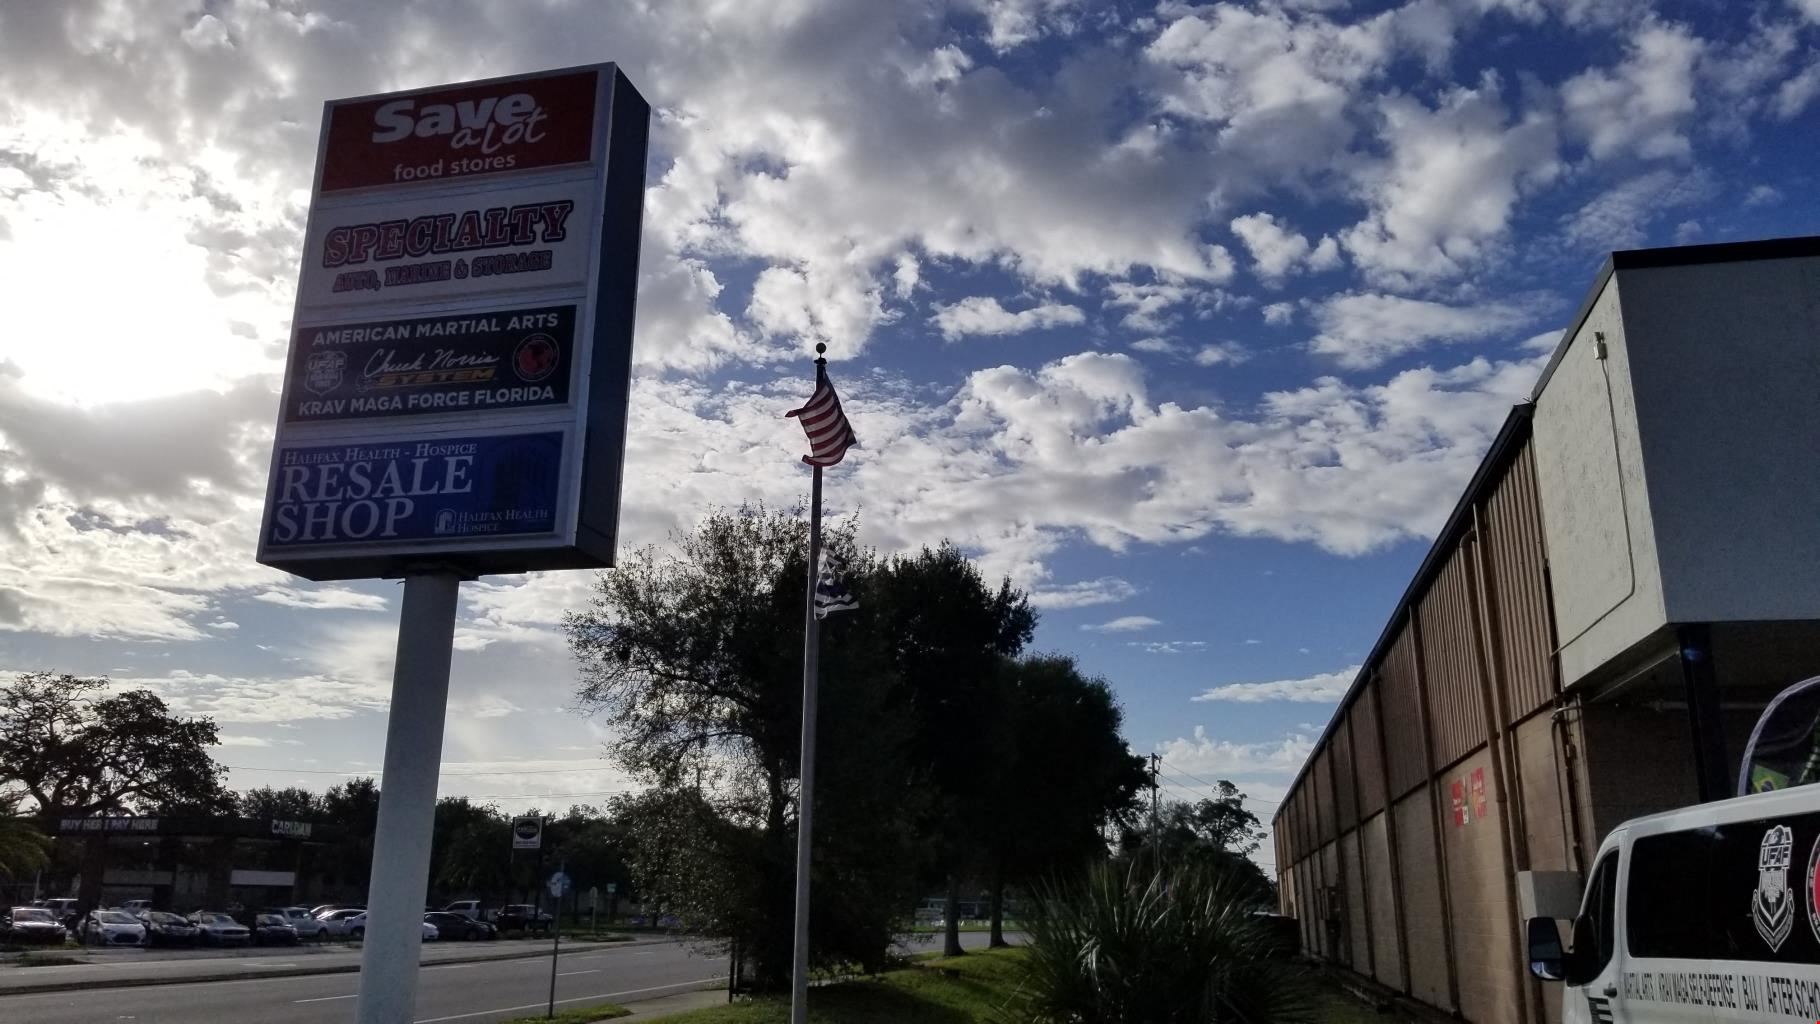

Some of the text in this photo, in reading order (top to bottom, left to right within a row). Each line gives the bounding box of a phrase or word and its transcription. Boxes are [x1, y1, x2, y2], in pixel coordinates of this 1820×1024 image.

[372, 93, 536, 143] Save
[393, 153, 516, 181] food stores
[323, 200, 575, 268] SPECIALTY
[384, 260, 452, 287] MARINE
[453, 258, 469, 280] &
[471, 250, 553, 278] STORAGE
[311, 313, 559, 346] AMERICAN MARTIAL ARTS
[364, 347, 425, 378] Chuck
[428, 348, 500, 370] Norris
[377, 368, 497, 386] SYSTEM
[298, 384, 555, 417] KRAV MAGA FORCE FLORIDA
[284, 450, 341, 466] HALIFAX
[345, 447, 401, 462] HEALTH
[416, 442, 478, 459] HOSPICE
[278, 455, 474, 504] RESALE
[272, 497, 414, 543] SHOP
[459, 508, 548, 522] HALIFAX HEALTH
[59, 819, 82, 831] BUY
[111, 818, 130, 831] PAY
[131, 818, 160, 831] HERE
[1761, 845, 1790, 867] UFAF
[1742, 975, 1758, 1011] BJJ
[1766, 976, 1797, 1016] AFTER
